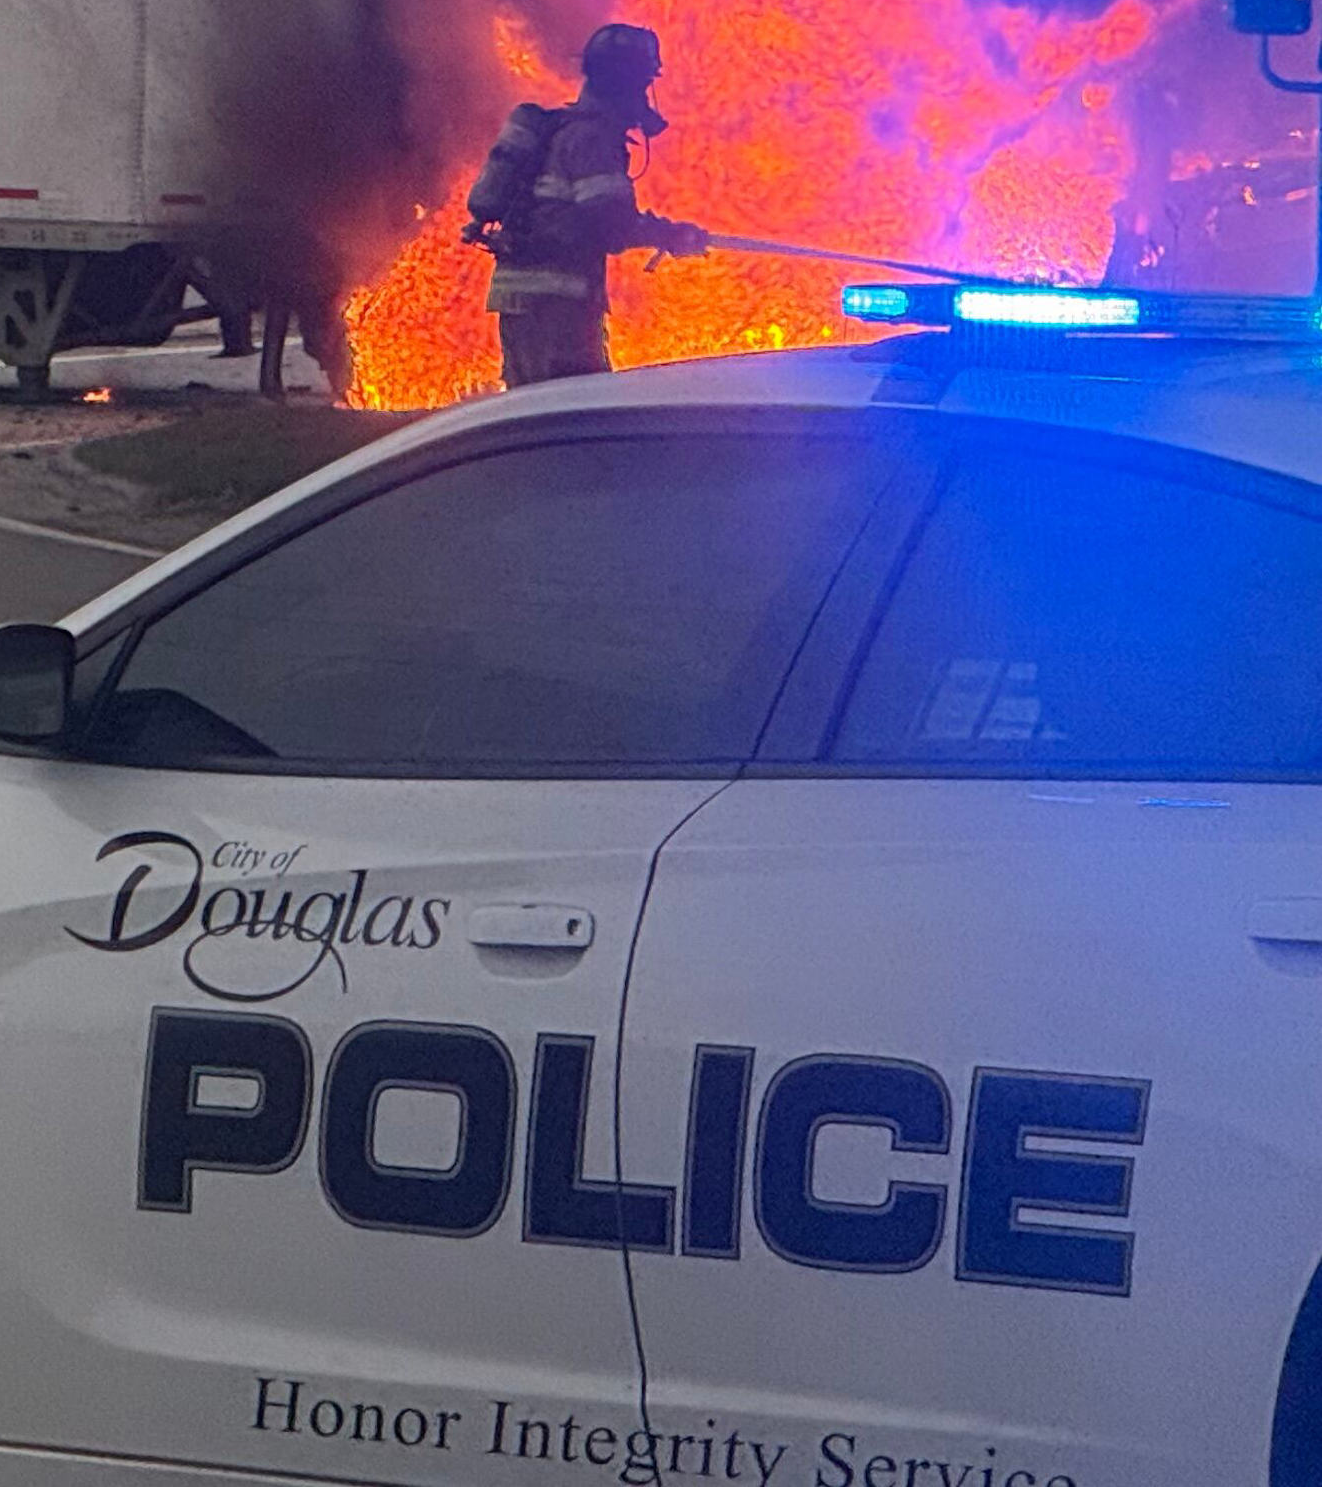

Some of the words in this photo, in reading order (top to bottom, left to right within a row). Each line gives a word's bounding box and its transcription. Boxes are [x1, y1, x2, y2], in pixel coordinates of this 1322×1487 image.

[63, 830, 451, 1003] Douglas
[212, 840, 265, 877] City
[270, 843, 308, 877] of
[136, 1005, 1153, 1299] POLICE
[251, 1377, 462, 1449] Honor
[485, 1399, 788, 1487] Integrity
